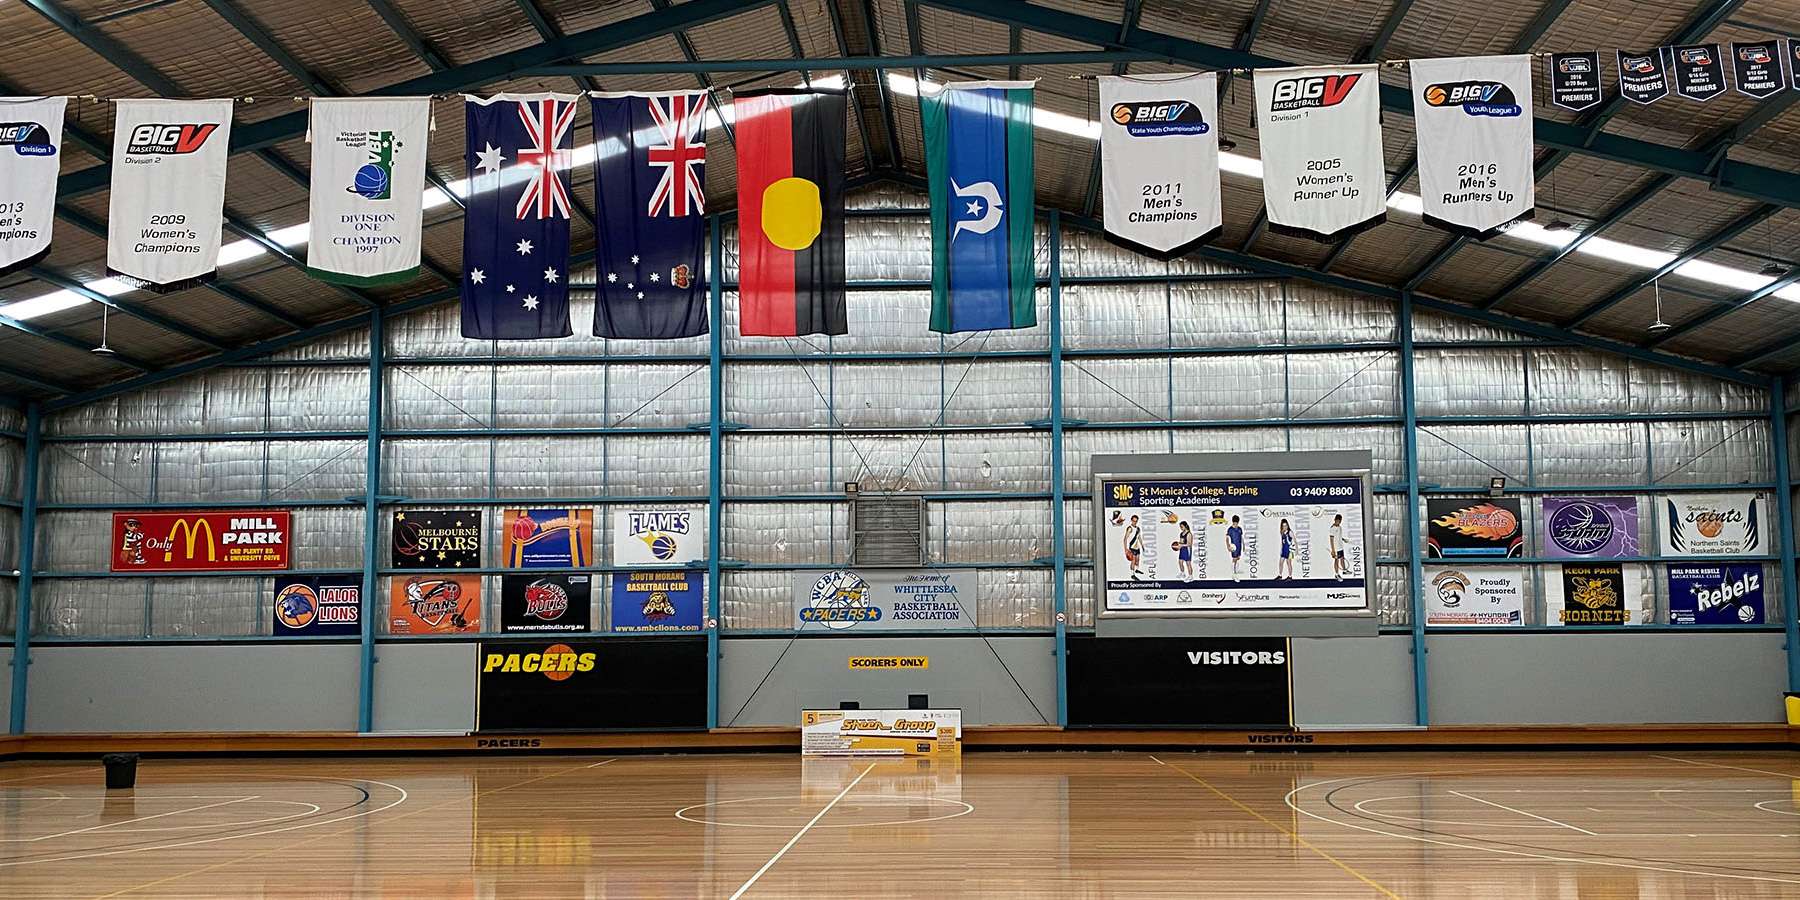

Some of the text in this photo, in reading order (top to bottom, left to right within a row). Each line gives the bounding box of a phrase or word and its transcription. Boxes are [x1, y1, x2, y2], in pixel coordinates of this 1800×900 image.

[1624, 80, 1663, 92] PREMIERS
[1686, 84, 1717, 92] PREMIERS
[1744, 82, 1776, 90] PREMIERS
[1274, 100, 1320, 110] BASKETBALL
[1271, 114, 1301, 122] Division
[1306, 158, 1341, 170] 2005
[1458, 164, 1497, 176] 2016
[1297, 173, 1353, 186] Women's
[1460, 176, 1496, 189] Men's
[1142, 183, 1182, 196] 2011
[1294, 187, 1359, 202] Runner Up
[1144, 195, 1182, 208] Men's
[1442, 190, 1514, 204] Runners Up
[0, 202, 24, 214] 013
[151, 215, 186, 224] 2009
[342, 214, 395, 222] DIVISION
[1128, 210, 1198, 223] Champions
[354, 224, 381, 232] ONE
[141, 229, 196, 240] Women's
[333, 236, 400, 245] CHAMPION
[134, 242, 200, 255] Champions
[356, 246, 378, 254] 1997
[1114, 485, 1134, 500] SMC
[1140, 486, 1258, 496] St Monica's College, Epping
[1290, 486, 1353, 496] 03 9409 8800
[1140, 496, 1220, 506] Sporting Academies
[1686, 509, 1744, 523] saints
[230, 518, 277, 530] MILL
[629, 513, 690, 536] FLAMES
[1458, 519, 1508, 528] BLAZERS
[222, 532, 283, 544] PARK
[418, 528, 478, 536] MELBOURNE
[146, 536, 173, 551] Only
[418, 536, 478, 550] STARS
[1198, 528, 1207, 579] BASKETBALL
[1250, 535, 1258, 578] FOOTBALL
[1302, 540, 1310, 578] NETBALL
[1352, 546, 1361, 577] TENNIS
[1148, 564, 1156, 580] AFL
[626, 582, 688, 592] BASKETBALL CLUB
[812, 572, 842, 600] WCBA
[1480, 579, 1510, 587] Proudly
[894, 585, 958, 594] WHITTLESEA
[1698, 573, 1760, 612] Rebelz
[319, 588, 358, 604] LALOR
[411, 600, 458, 614] TITANS
[894, 602, 958, 610] BASKETBALL
[319, 606, 358, 622] LIONS
[813, 608, 866, 621] PACERS
[892, 611, 959, 620] ASSOCIATION
[1559, 610, 1631, 622] HORNETS
[484, 652, 596, 672] PACERS
[852, 658, 925, 667] SCORERS ONLY
[1188, 651, 1284, 664] VISITORS
[808, 714, 814, 724] 5
[894, 719, 936, 732] Group
[478, 739, 542, 748] PACERS
[1248, 735, 1313, 744] VISITORS
